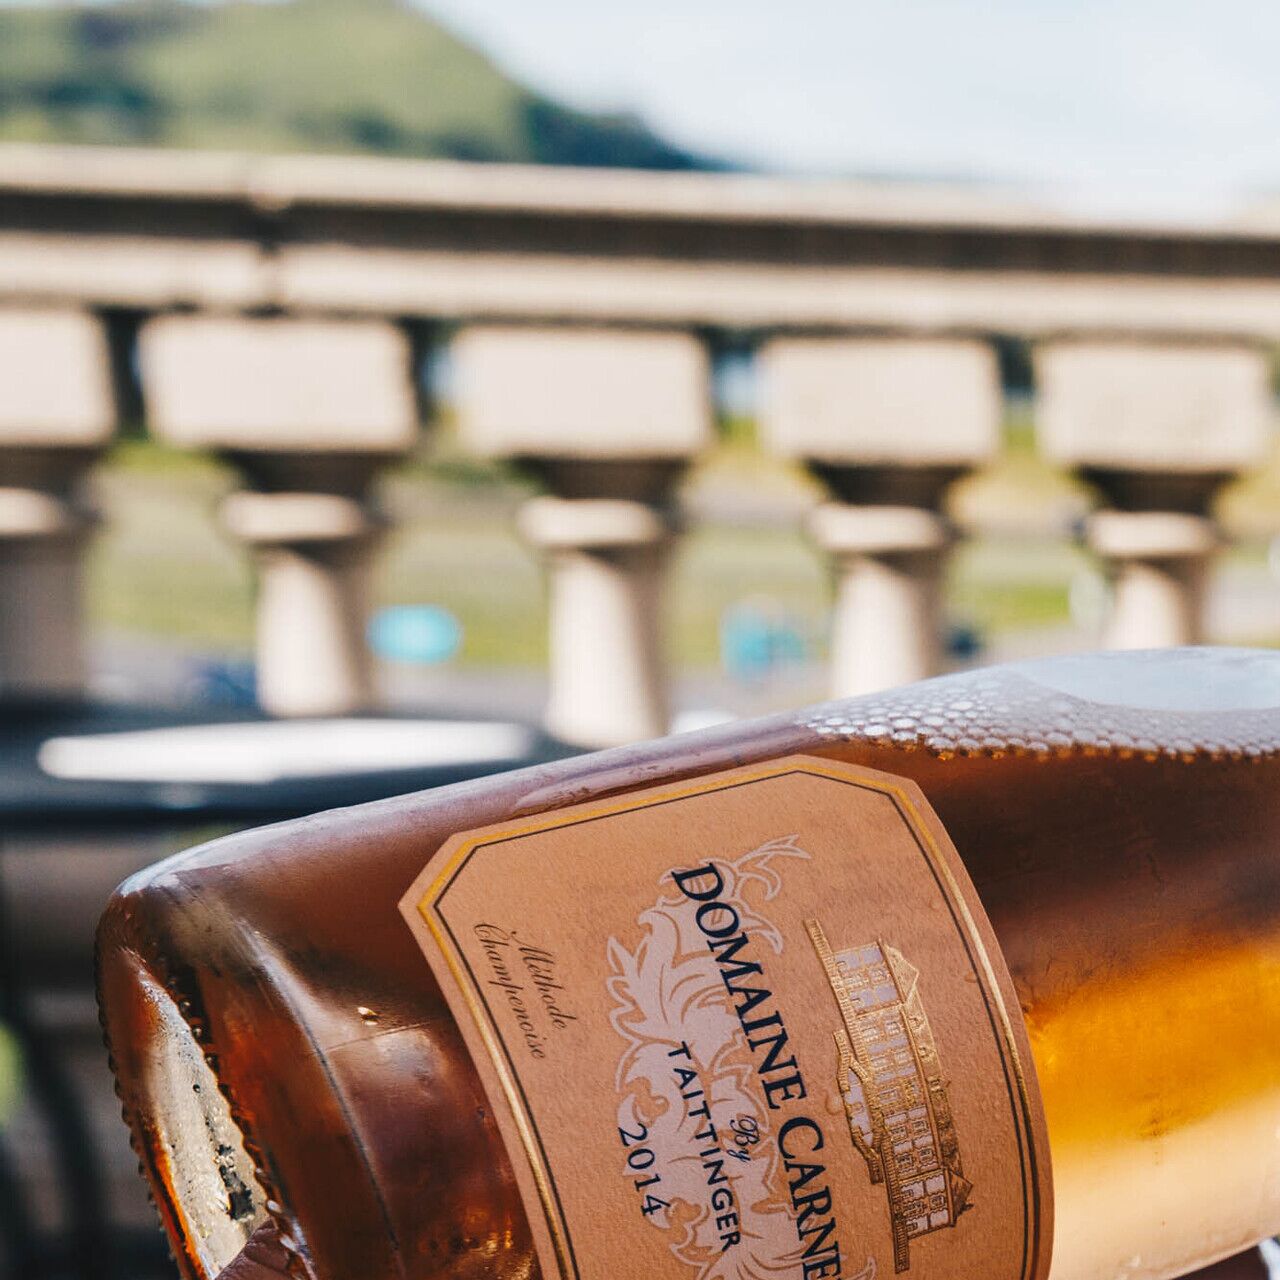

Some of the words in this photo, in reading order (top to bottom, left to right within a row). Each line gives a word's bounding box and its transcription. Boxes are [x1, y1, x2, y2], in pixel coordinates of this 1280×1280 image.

[473, 923, 547, 1060] Champenoise
[671, 862, 806, 1111] DOMAINE
[618, 1121, 671, 1217] 2014
[668, 1040, 741, 1253] TAITTINGER
[727, 1114, 761, 1163] By
